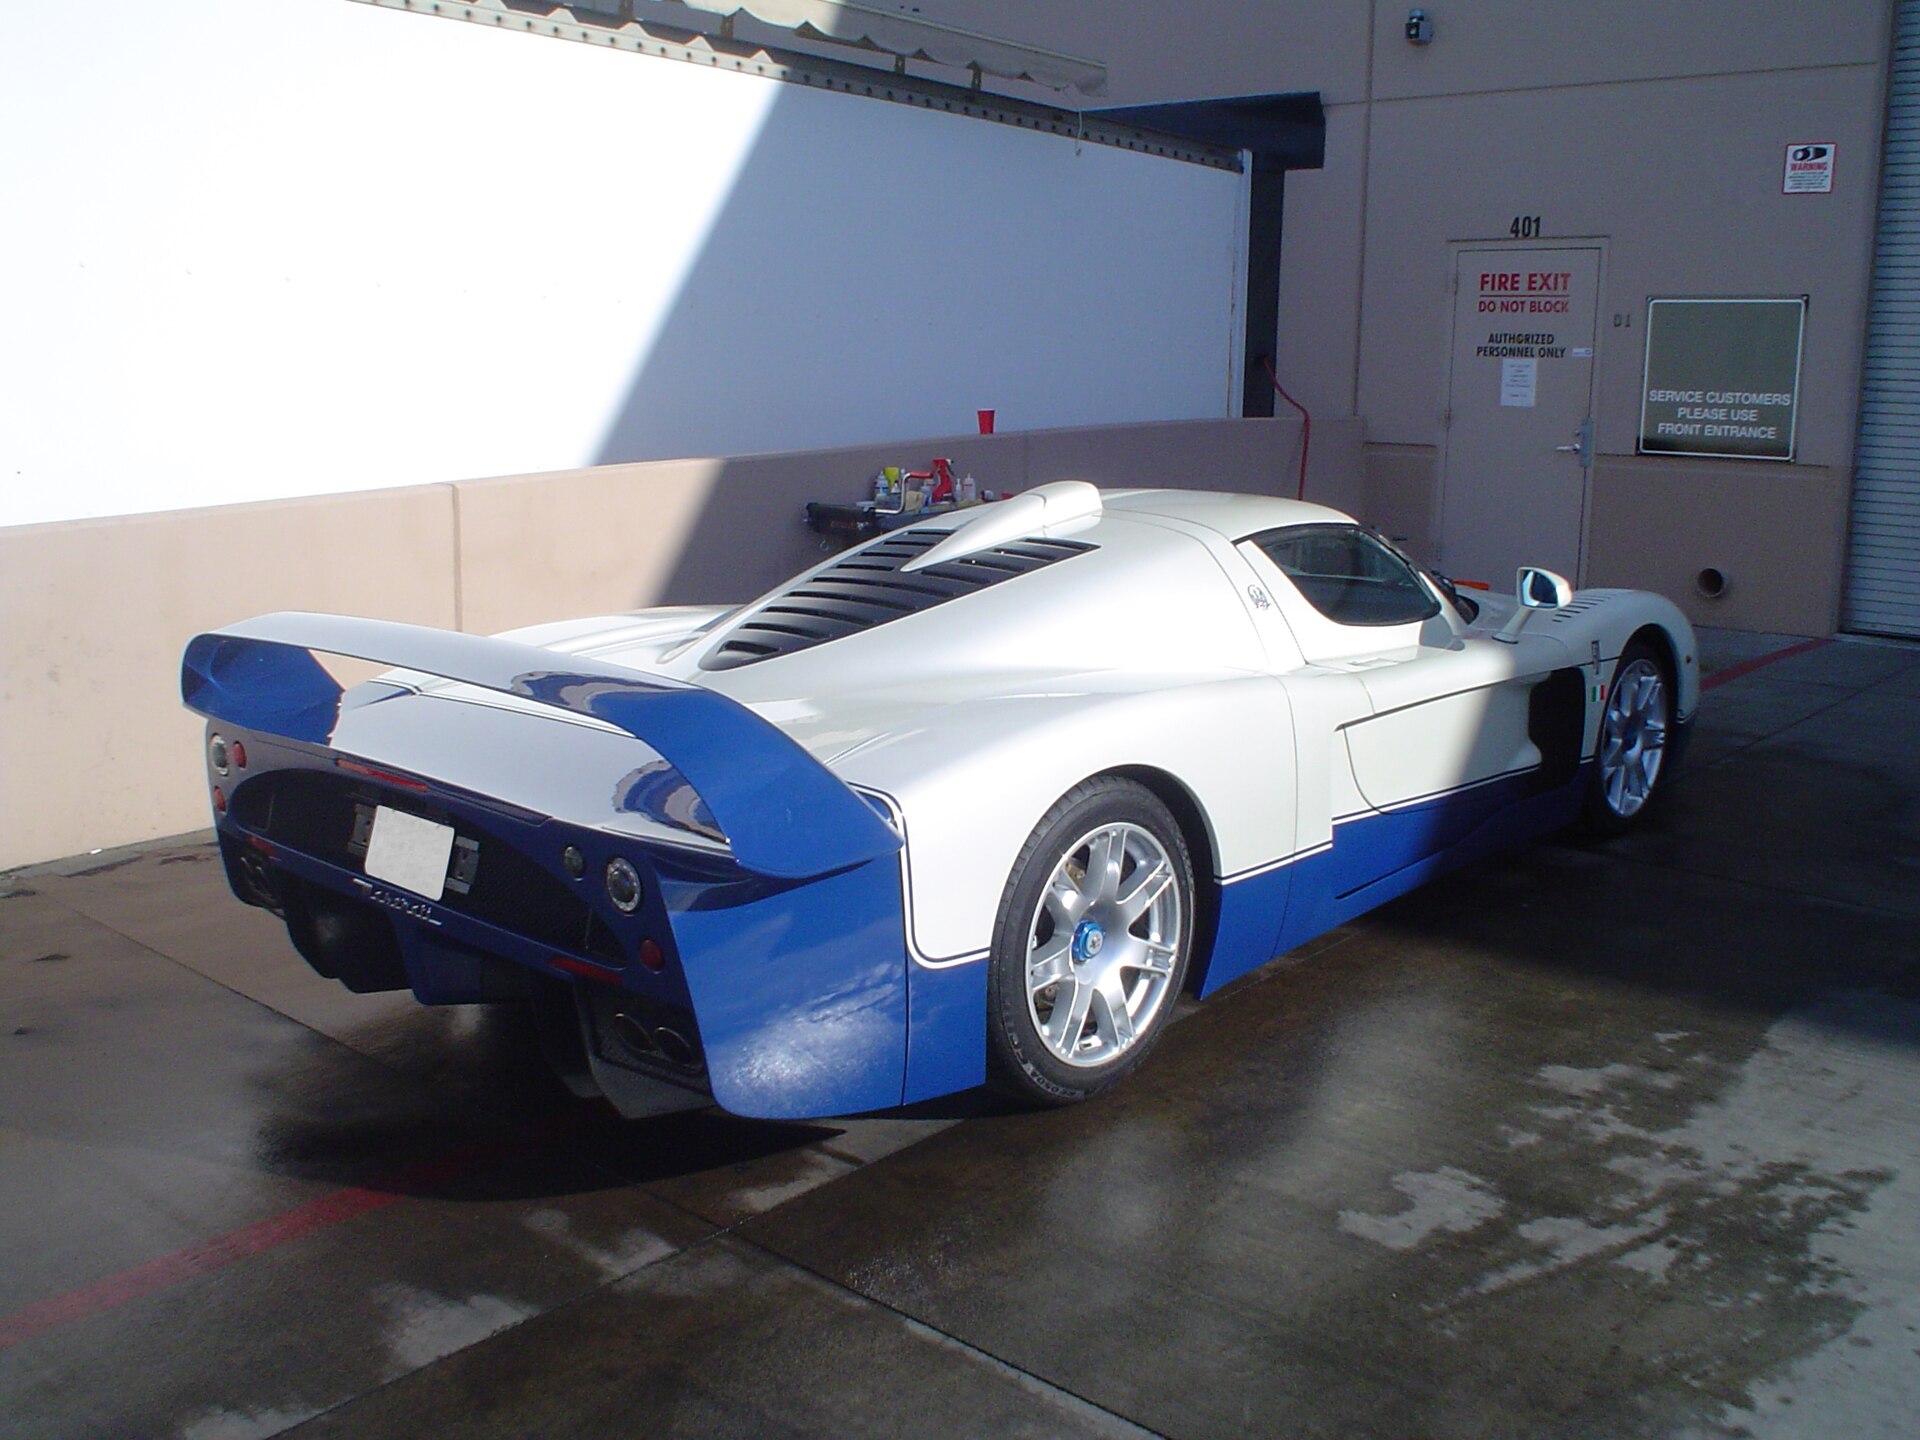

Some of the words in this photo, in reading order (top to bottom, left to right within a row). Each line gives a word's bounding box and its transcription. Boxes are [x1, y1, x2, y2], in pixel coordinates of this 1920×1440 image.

[1509, 215, 1541, 238] 401
[1480, 273, 1520, 291] FIRE
[1527, 272, 1571, 291] EXIT
[1478, 301, 1496, 313] DO
[1500, 301, 1525, 313] NOT
[1529, 301, 1569, 313] BLOCK
[1488, 333, 1555, 345] AUTHORIZED
[1476, 346, 1535, 358] PERSONNEL
[1538, 347, 1566, 358] ONLY
[1649, 390, 1703, 403] SERVICE
[1706, 391, 1791, 406] CUSTOMERS
[1677, 407, 1727, 420] PLEASE
[1731, 409, 1758, 421] USE
[1657, 423, 1702, 436] FRONT
[1704, 424, 1776, 439] ENTRANCE
